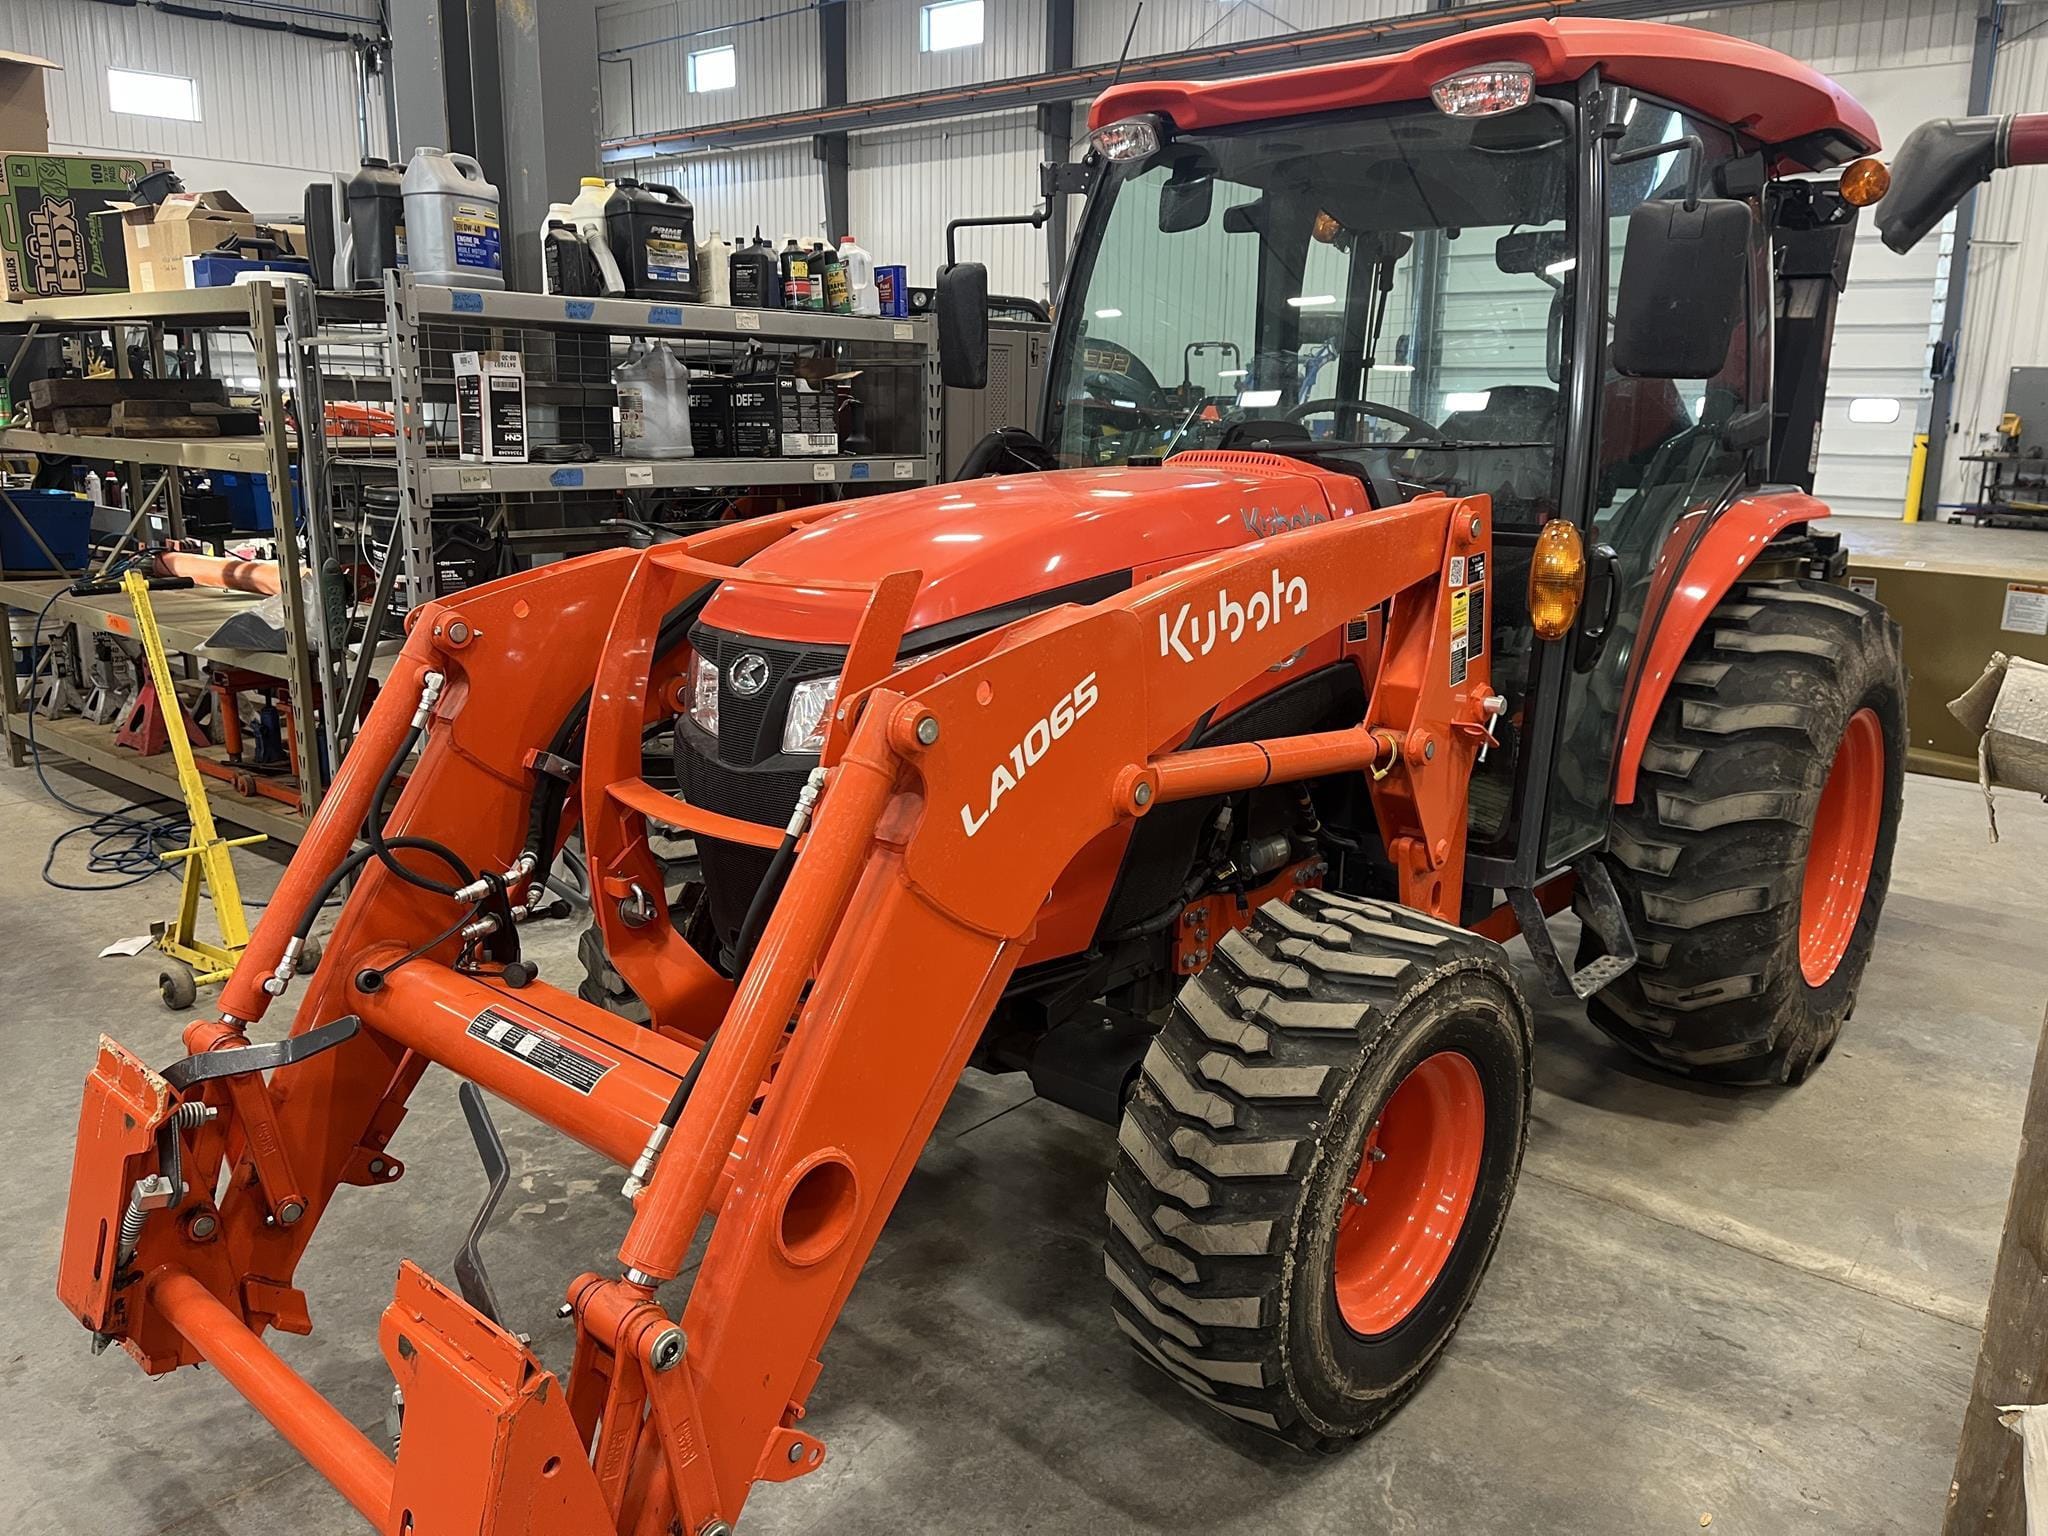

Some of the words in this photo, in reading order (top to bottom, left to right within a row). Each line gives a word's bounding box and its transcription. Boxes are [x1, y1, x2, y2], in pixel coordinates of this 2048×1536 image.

[90, 163, 103, 185] 100
[32, 205, 58, 293] TOOL
[47, 196, 82, 291] BOX
[650, 225, 683, 236] PRIME
[74, 234, 85, 271] BRAND
[6, 257, 20, 293] SELLARS
[736, 393, 753, 407] DEF
[1158, 568, 1308, 663] Kubota
[960, 671, 1100, 837] LA1065
